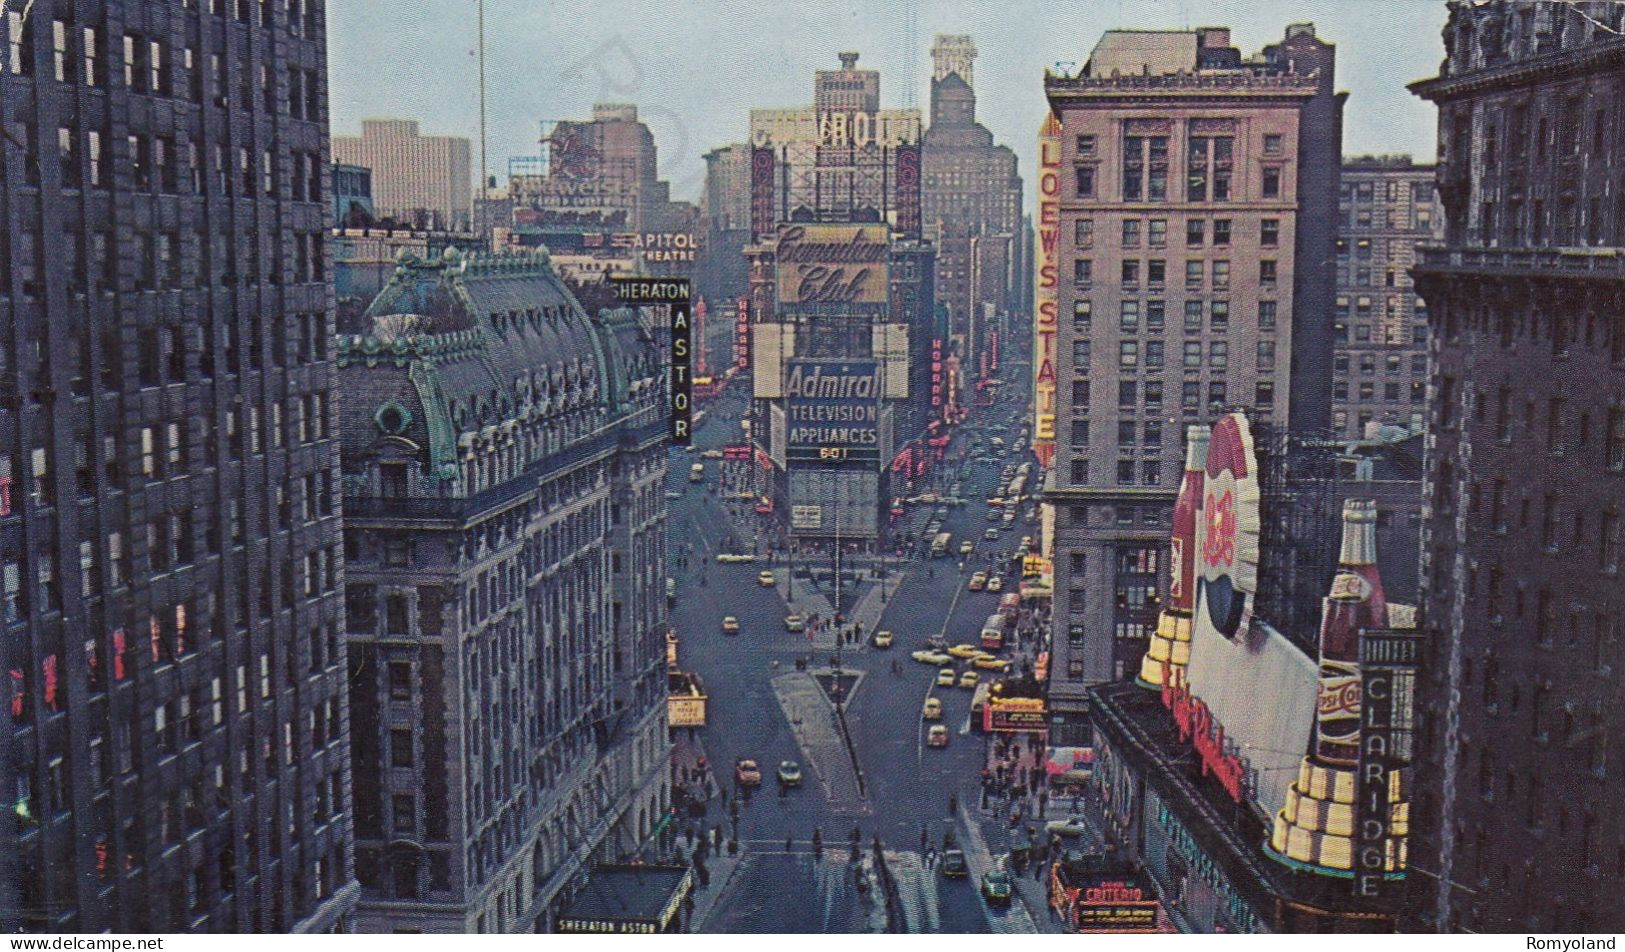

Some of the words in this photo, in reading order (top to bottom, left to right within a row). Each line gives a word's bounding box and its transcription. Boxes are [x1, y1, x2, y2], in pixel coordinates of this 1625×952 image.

[776, 224, 887, 262] Canadian
[612, 282, 690, 299] SHERATON
[797, 264, 870, 303] Club
[674, 311, 688, 437] ASTOR
[786, 365, 882, 399] Admiral
[1037, 302, 1056, 439] STATE
[790, 405, 877, 421] TELEVISION
[789, 427, 877, 444] APPLIANCES
[1361, 677, 1387, 897] CLARIDGE
[558, 919, 615, 932] SHERATON
[621, 922, 656, 934] ASTOR
